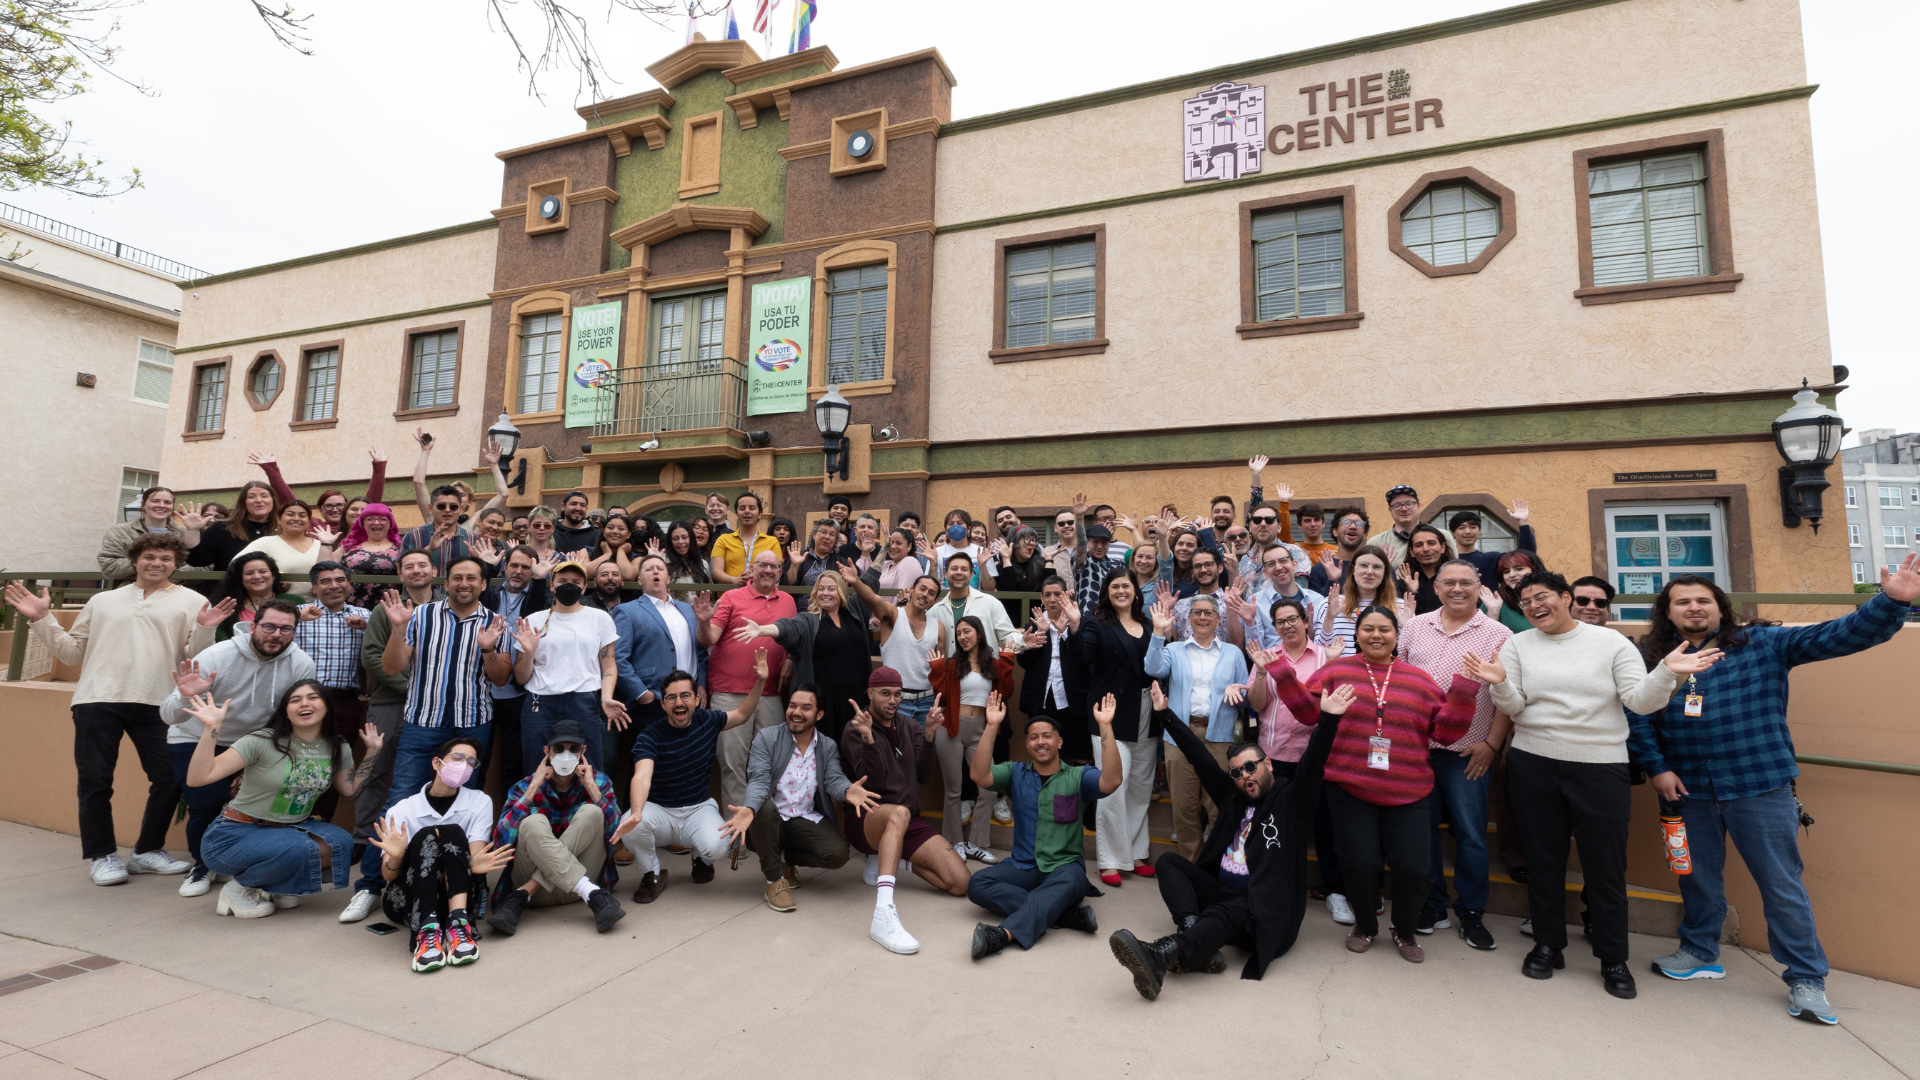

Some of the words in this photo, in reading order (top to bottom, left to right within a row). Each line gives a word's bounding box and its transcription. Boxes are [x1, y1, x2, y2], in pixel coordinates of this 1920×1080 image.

[1299, 72, 1384, 115] THE
[1389, 91, 1410, 100] UNITY
[1268, 98, 1444, 155] CENTER
[756, 283, 805, 306] ¡VOTA!
[578, 307, 617, 329] VOTE!
[764, 307, 782, 317] USA
[784, 305, 796, 315] TU
[760, 315, 799, 332] PODER
[577, 329, 592, 339] USE
[593, 326, 614, 337] YOUR
[577, 336, 612, 351] POWER
[774, 346, 791, 354] VOTE
[586, 364, 604, 372] VOTED
[762, 381, 774, 389] THE
[777, 379, 803, 388] CENTER
